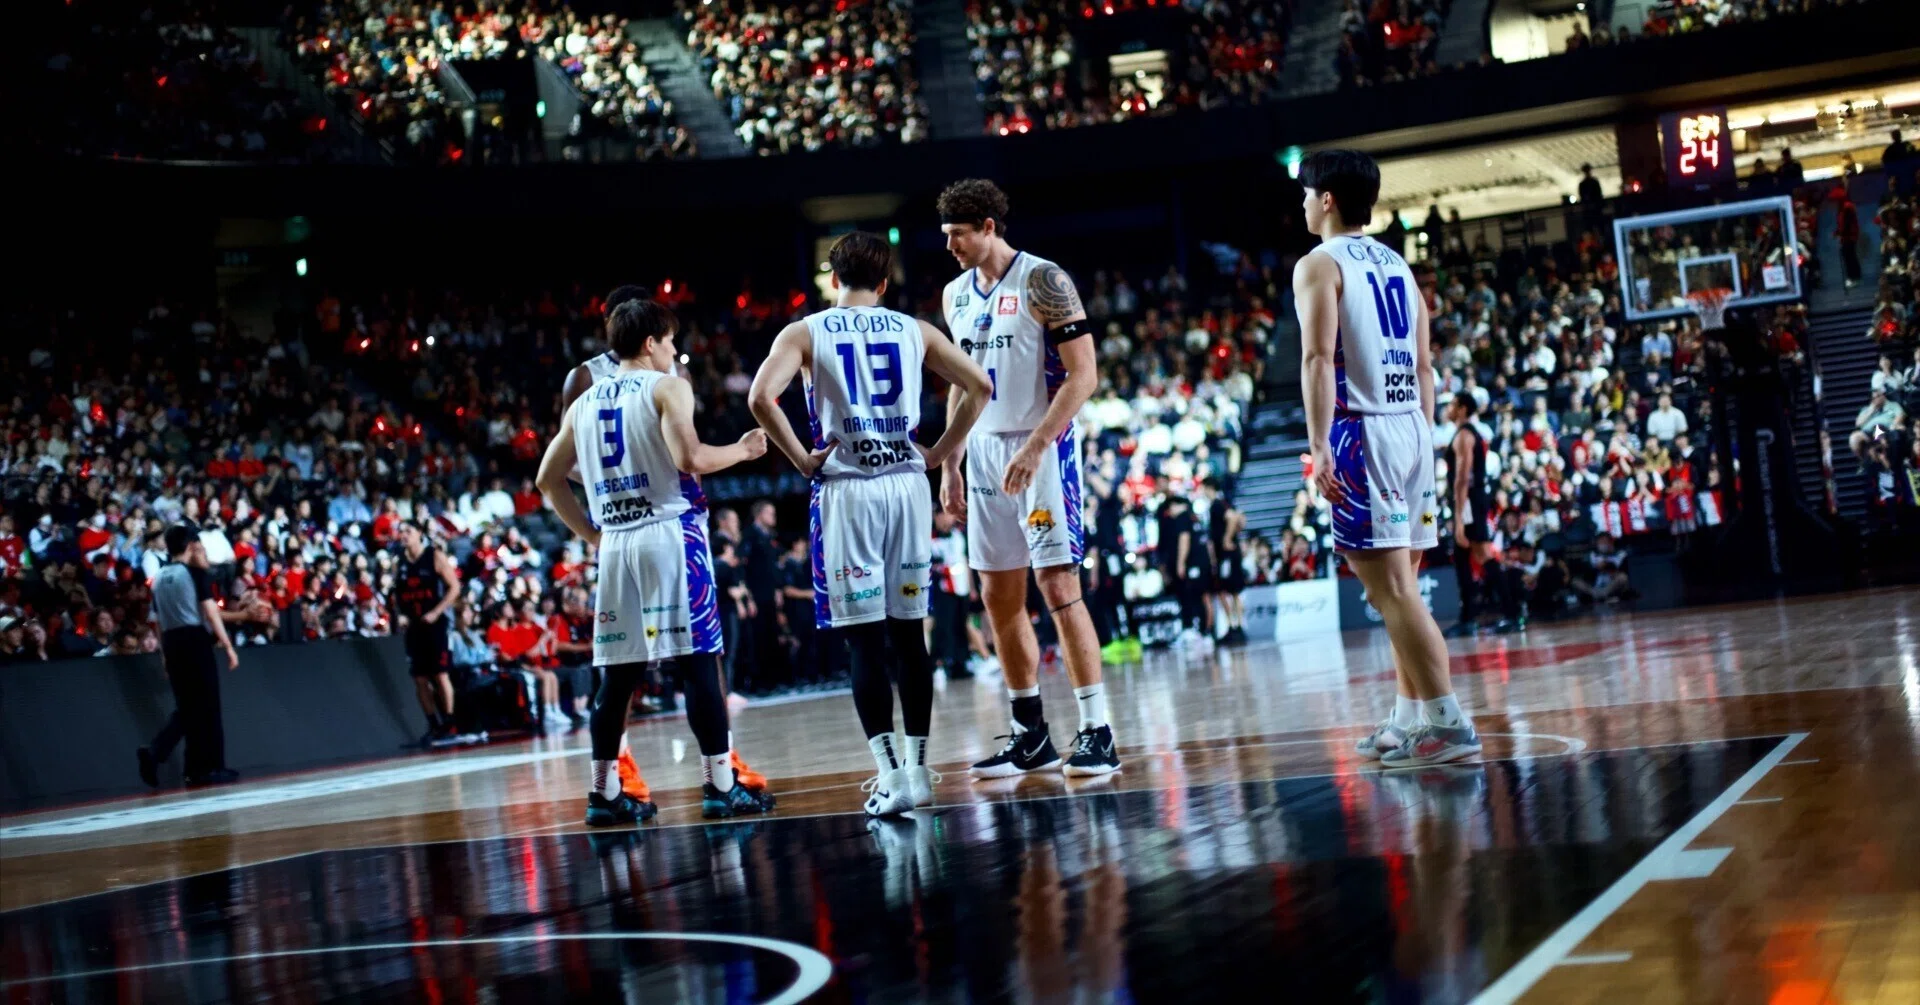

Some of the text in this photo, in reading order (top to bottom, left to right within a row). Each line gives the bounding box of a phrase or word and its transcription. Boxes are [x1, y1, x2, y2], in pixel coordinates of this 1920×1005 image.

[1680, 140, 1719, 174] 24
[1366, 271, 1409, 339] 10
[824, 314, 904, 333] GLOBIS
[586, 376, 644, 401] LOBIS
[835, 342, 904, 407] 13
[598, 407, 626, 468] 3
[835, 565, 872, 582] EPOS
[595, 631, 627, 644] OMENO
